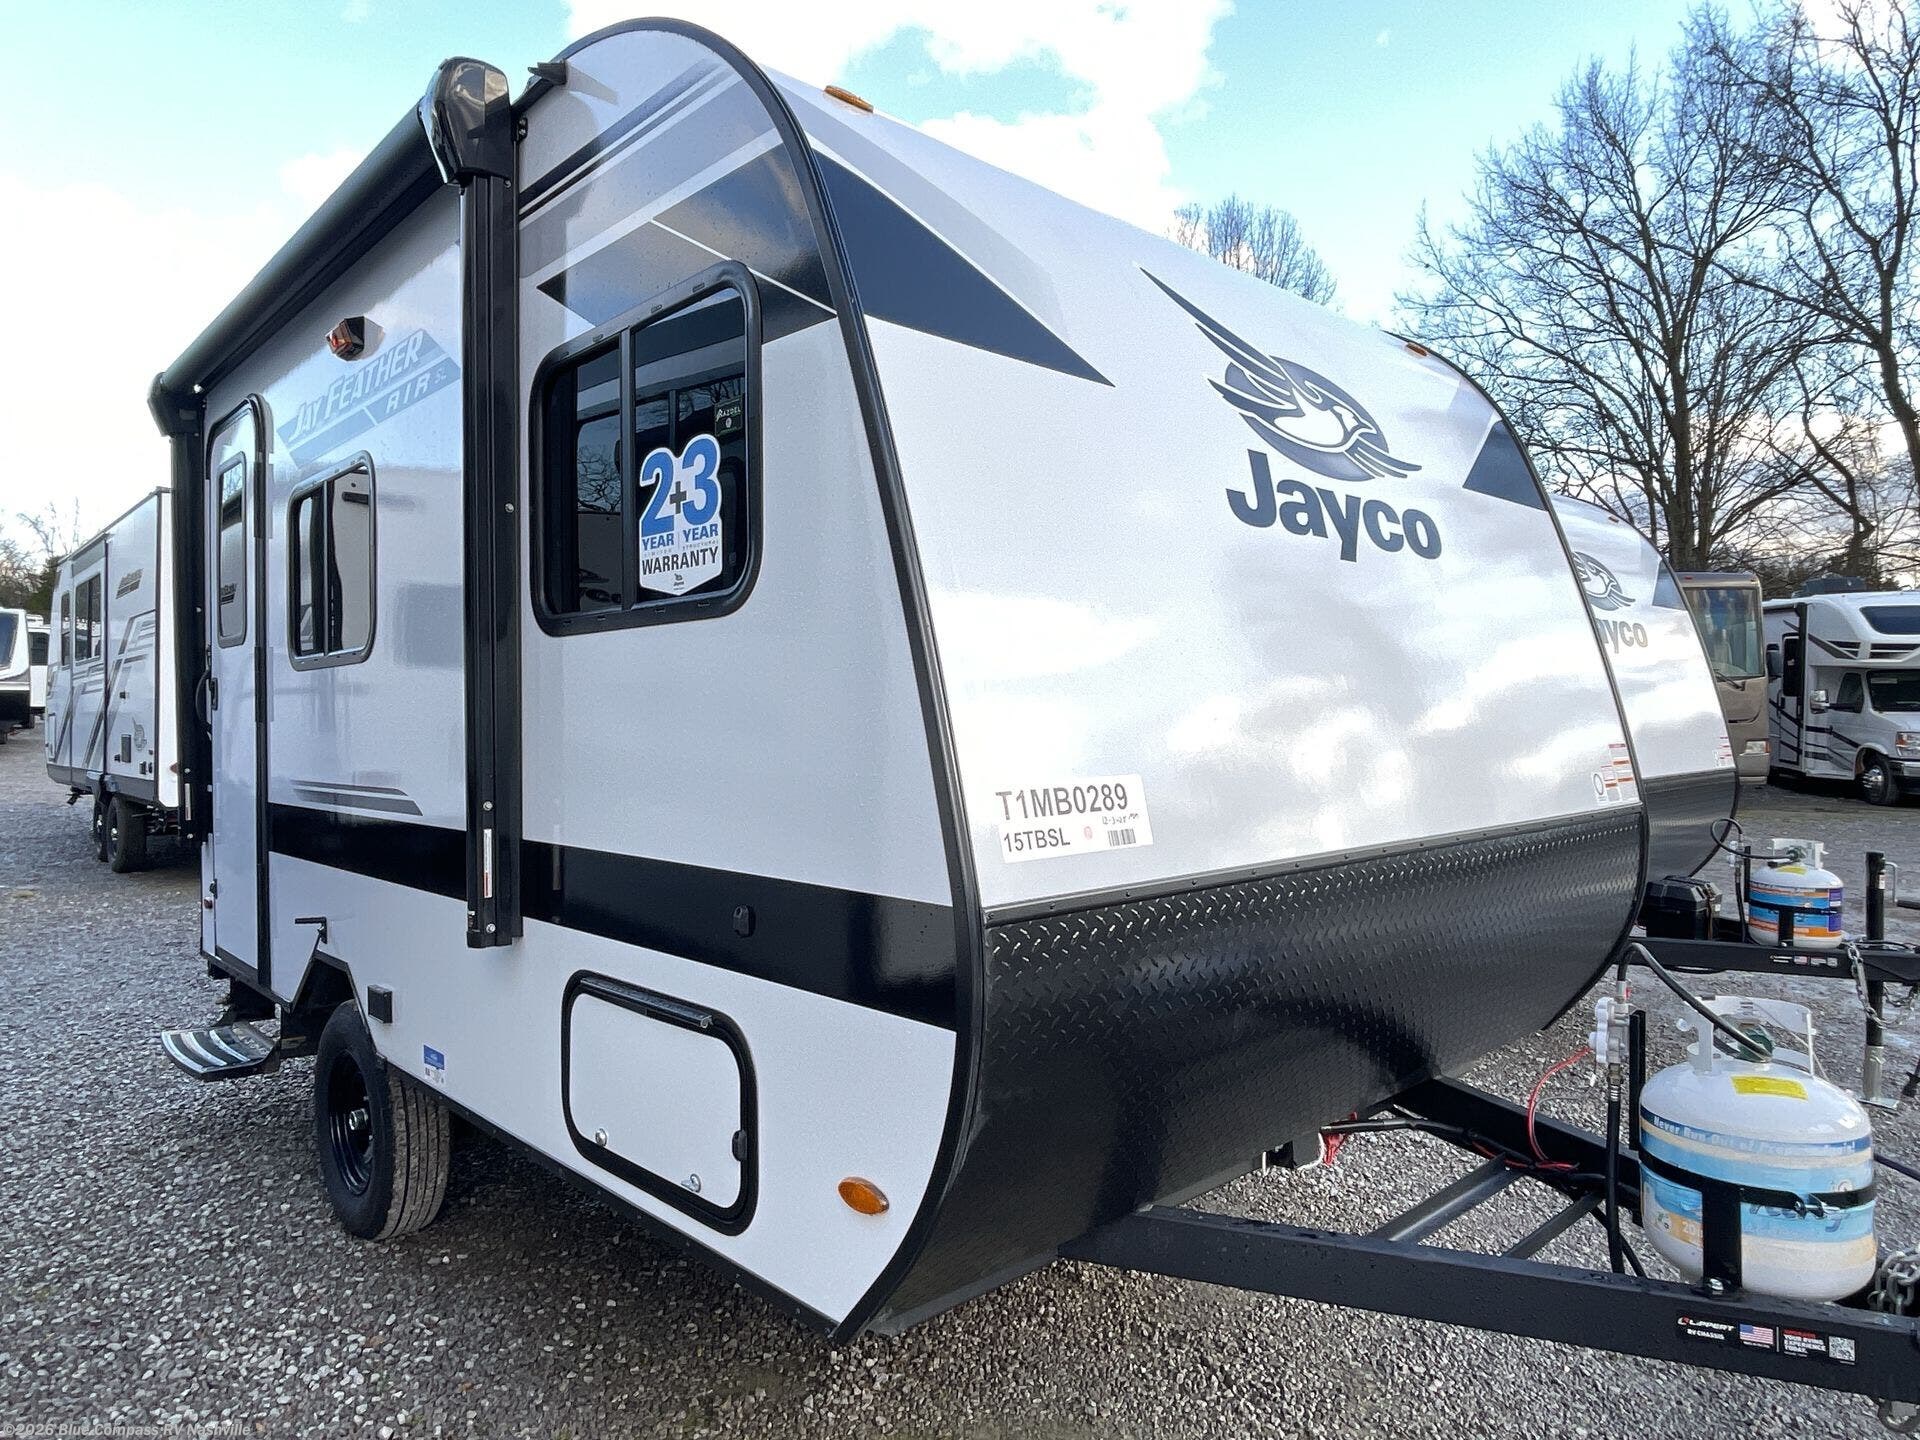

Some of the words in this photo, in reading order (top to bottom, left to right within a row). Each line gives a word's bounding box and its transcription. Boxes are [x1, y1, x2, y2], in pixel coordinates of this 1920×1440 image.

[288, 399, 322, 442] JAY
[324, 330, 424, 419] FEATHER
[386, 371, 432, 414] AIR
[1226, 448, 1442, 562] Jayco
[642, 532, 674, 551] YEAR
[683, 523, 718, 542] YEAR
[642, 546, 718, 575] WARRANTY
[1597, 619, 1648, 653] ayco
[995, 783, 1128, 820] T1MB0289
[1004, 828, 1071, 852] 15TBSL
[1654, 1116, 1680, 1134] Never
